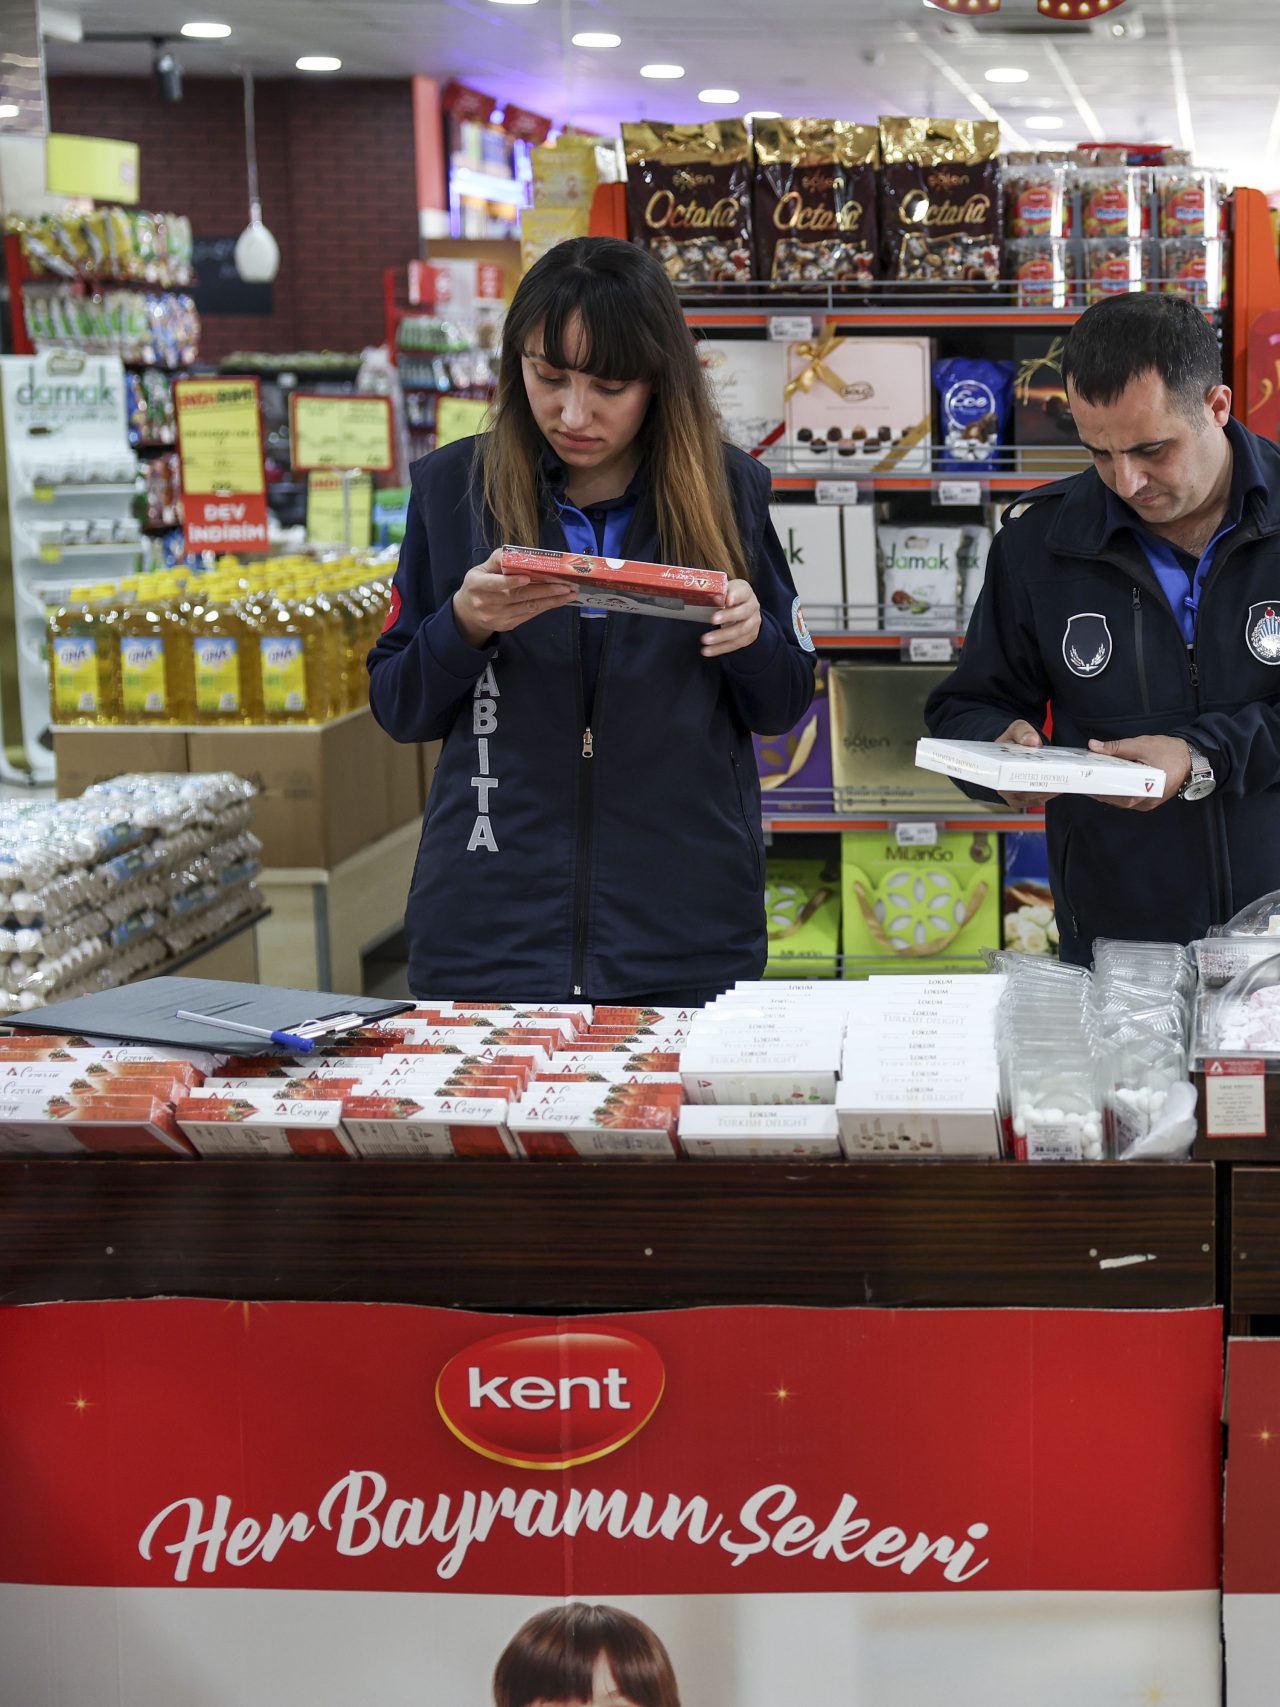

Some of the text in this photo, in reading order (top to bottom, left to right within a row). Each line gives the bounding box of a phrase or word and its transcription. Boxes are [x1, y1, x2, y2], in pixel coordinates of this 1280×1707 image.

[885, 543, 949, 570] damak
[467, 651, 500, 852] ABITA
[290, 1102, 329, 1122] Cezerye
[454, 1100, 494, 1119] Cezerye
[717, 1118, 809, 1128] TURKISH DELIGHT
[467, 1366, 631, 1410] kent
[138, 1470, 990, 1583] Her Bayramın Şekeri
